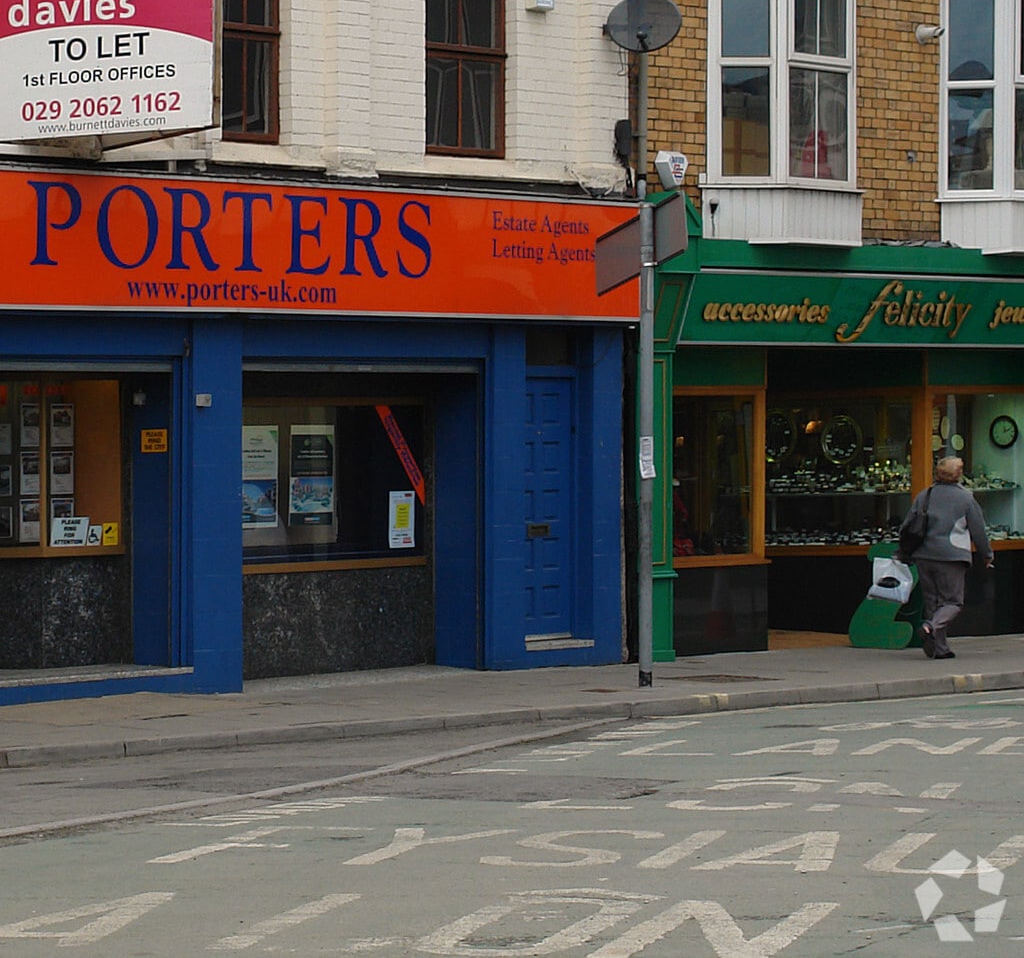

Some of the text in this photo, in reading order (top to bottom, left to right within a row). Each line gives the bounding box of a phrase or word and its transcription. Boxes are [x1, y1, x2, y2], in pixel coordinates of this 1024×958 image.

[48, 32, 150, 62] TO LET
[22, 64, 176, 87] 1st FLOOR OFFICES
[21, 91, 182, 122] 029 2062 1162
[38, 115, 166, 134] www.burnettdavies.com
[27, 180, 433, 279] PORTERS
[492, 211, 590, 238] Estate Agents
[492, 239, 596, 266] Letting Agents
[127, 277, 338, 306] www.porters-uk.com
[703, 298, 831, 324] accessories
[836, 280, 972, 343] felicity
